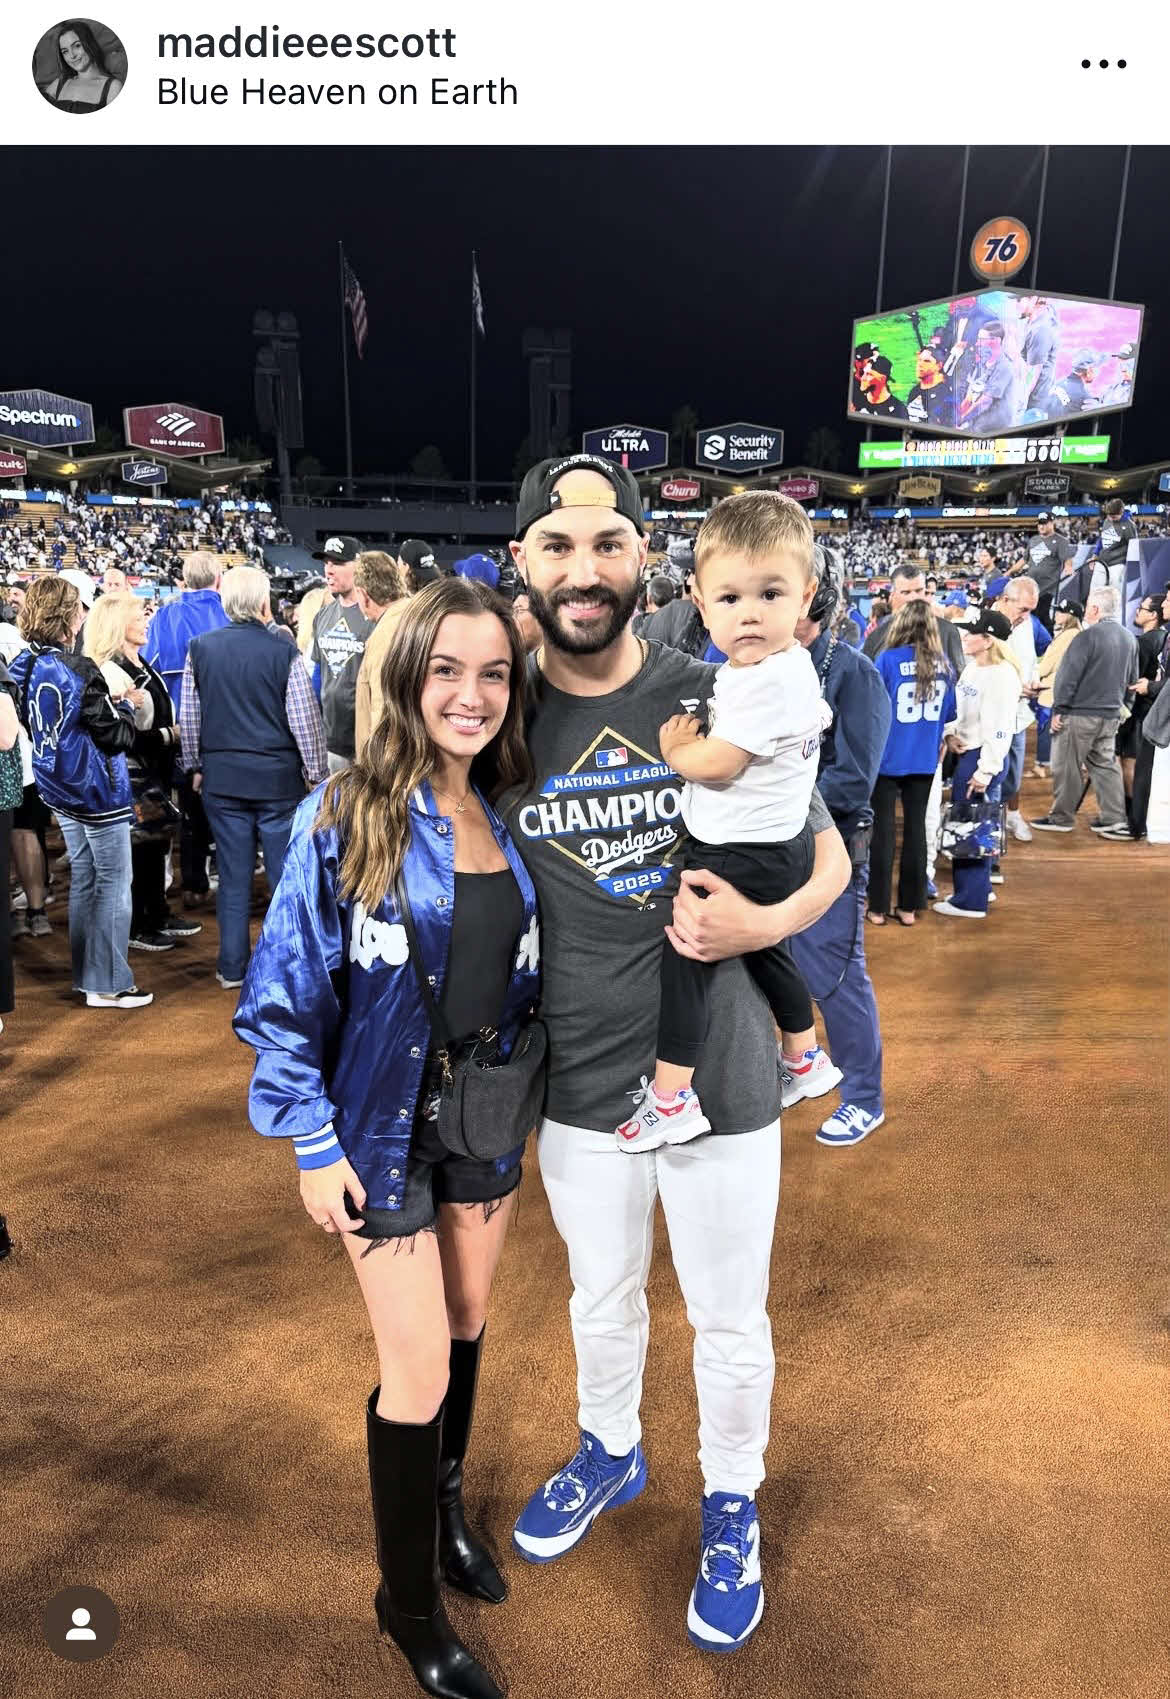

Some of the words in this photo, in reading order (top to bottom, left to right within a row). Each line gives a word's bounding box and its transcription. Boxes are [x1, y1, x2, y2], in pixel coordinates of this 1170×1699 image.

[983, 232, 1018, 263] 76
[0, 405, 77, 429] Spectrum
[150, 438, 168, 448] BANK
[168, 439, 177, 448] OF
[177, 440, 206, 449] AMERICA
[601, 438, 650, 452] ULTRA
[729, 434, 776, 450] Security
[729, 448, 769, 461] Benefit
[662, 482, 699, 498] Churu
[896, 680, 947, 723] 88
[553, 772, 620, 790] NATIONAL
[518, 786, 682, 839] CHAMPIO
[580, 824, 679, 869] Dodgers
[612, 870, 663, 894] 2025
[643, 1110, 660, 1127] N
